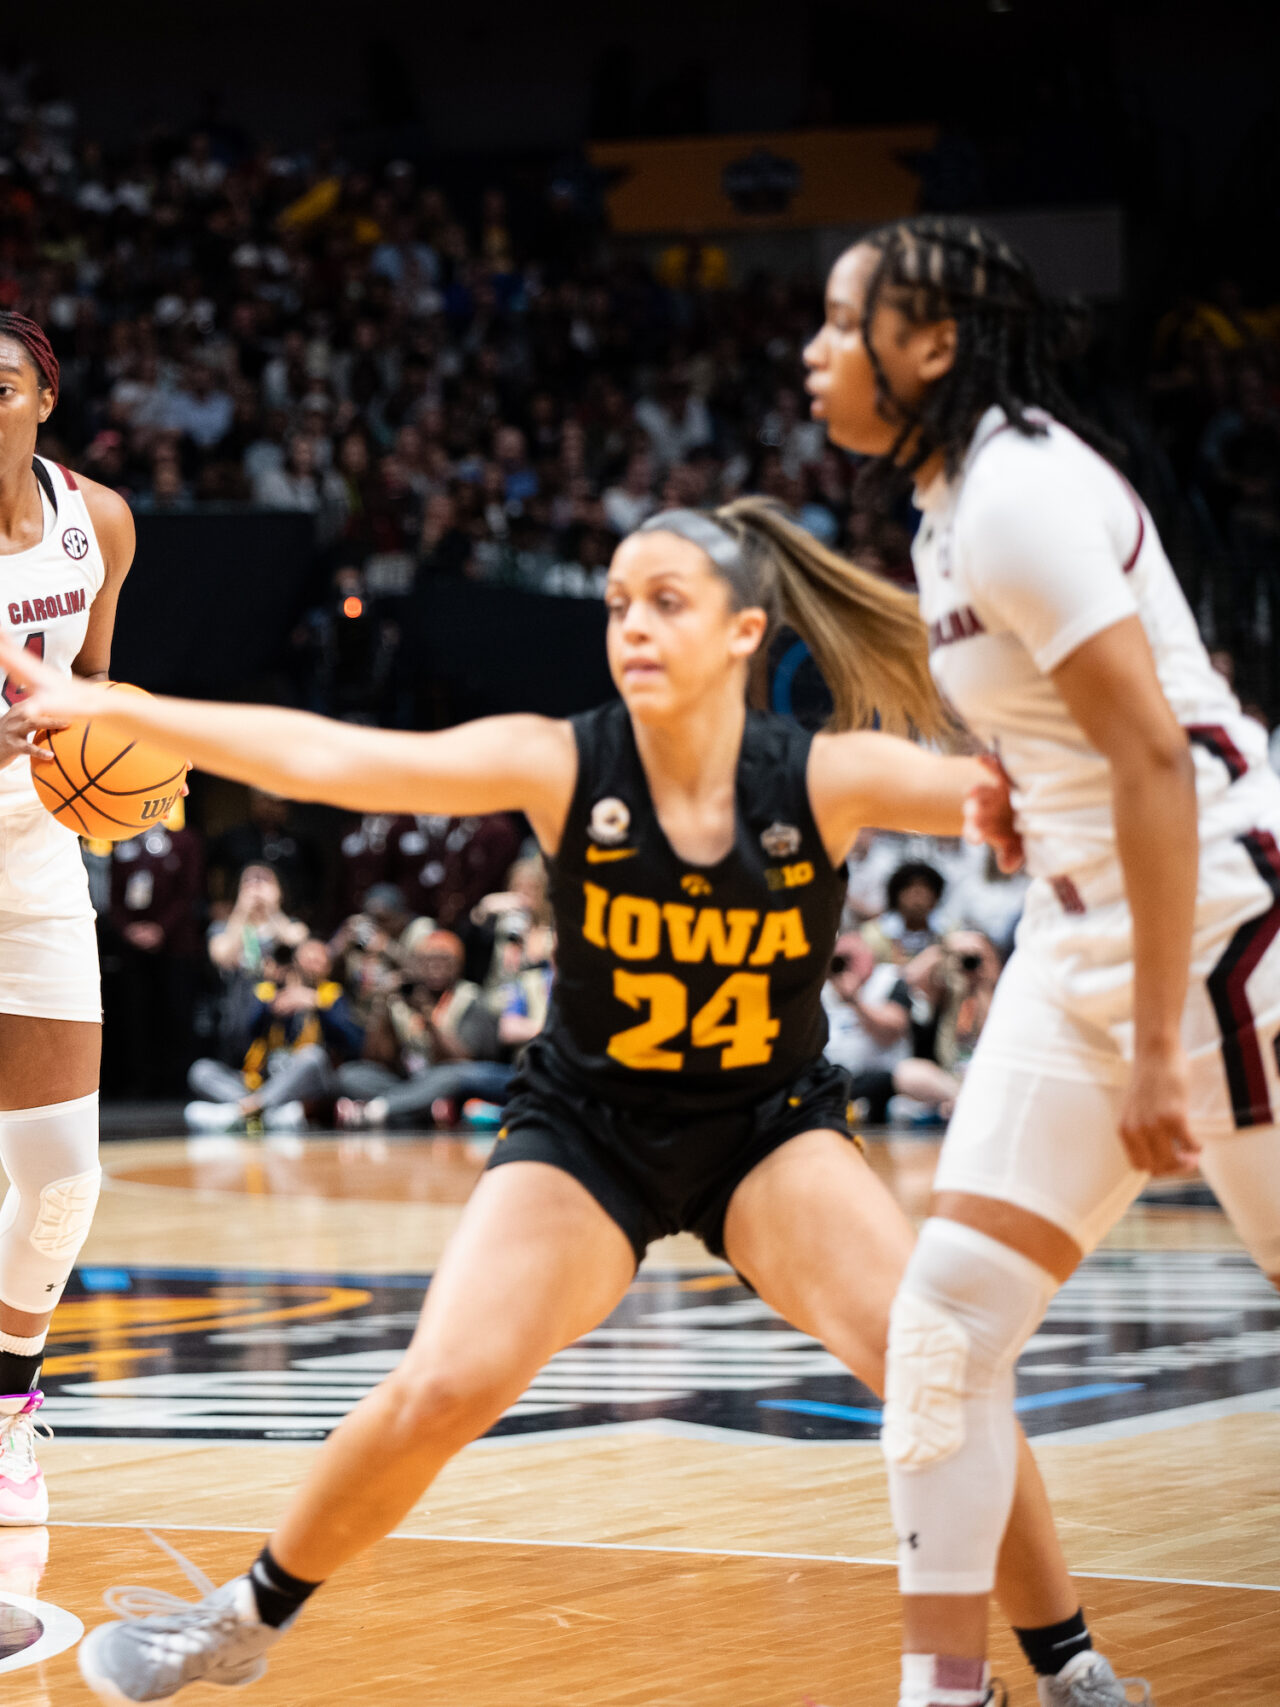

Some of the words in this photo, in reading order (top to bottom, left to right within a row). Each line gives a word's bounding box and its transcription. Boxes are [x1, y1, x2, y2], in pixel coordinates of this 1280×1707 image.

[8, 588, 87, 625] CAROLINA
[582, 880, 810, 966] IOWA
[606, 968, 780, 1072] 24
